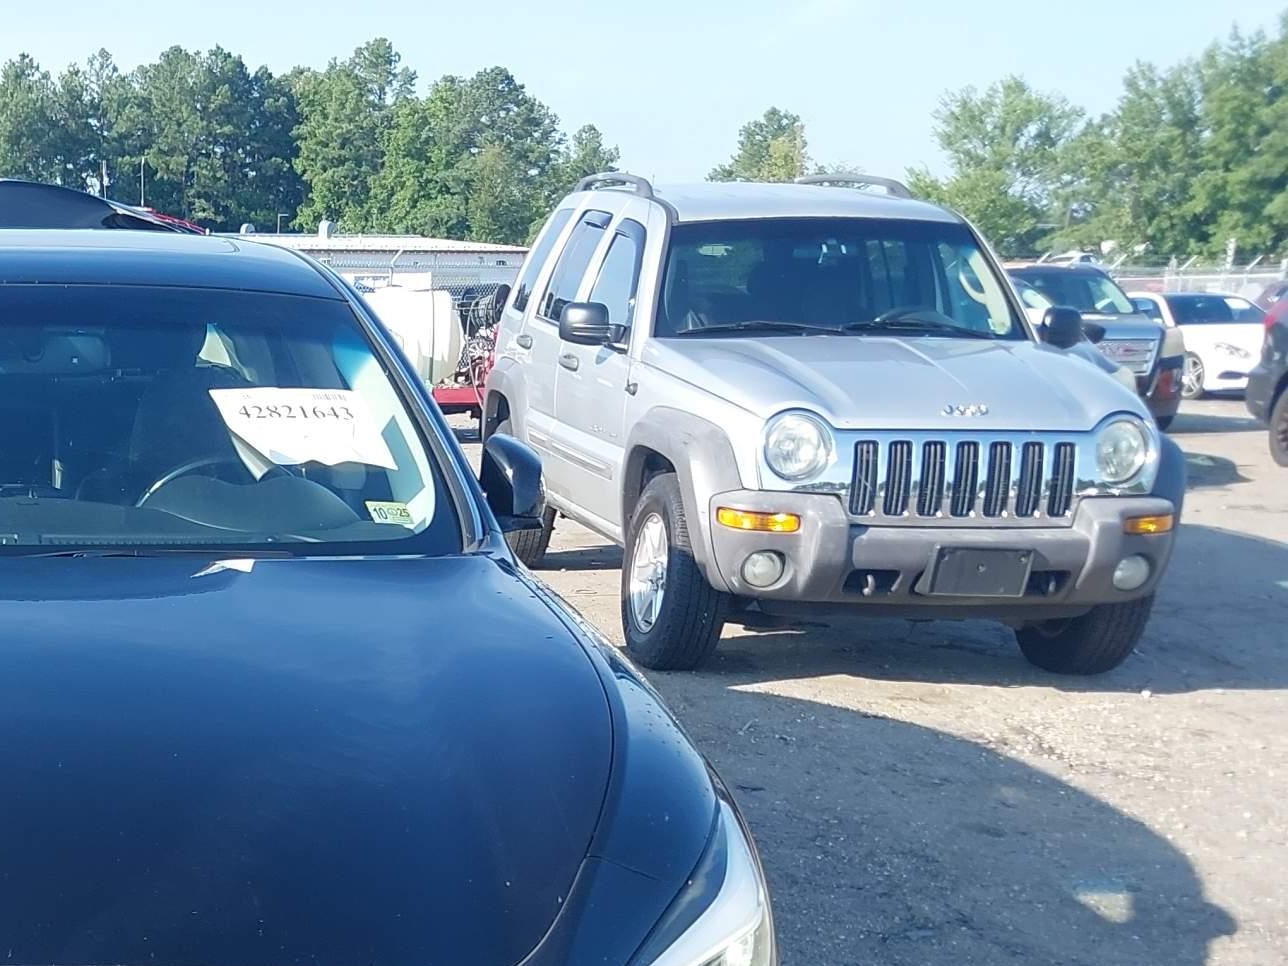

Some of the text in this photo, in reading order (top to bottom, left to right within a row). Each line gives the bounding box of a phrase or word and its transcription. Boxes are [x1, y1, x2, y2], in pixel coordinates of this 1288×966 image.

[238, 404, 355, 421] 42821643
[373, 506, 389, 520] 10
[396, 507, 411, 518] 25
